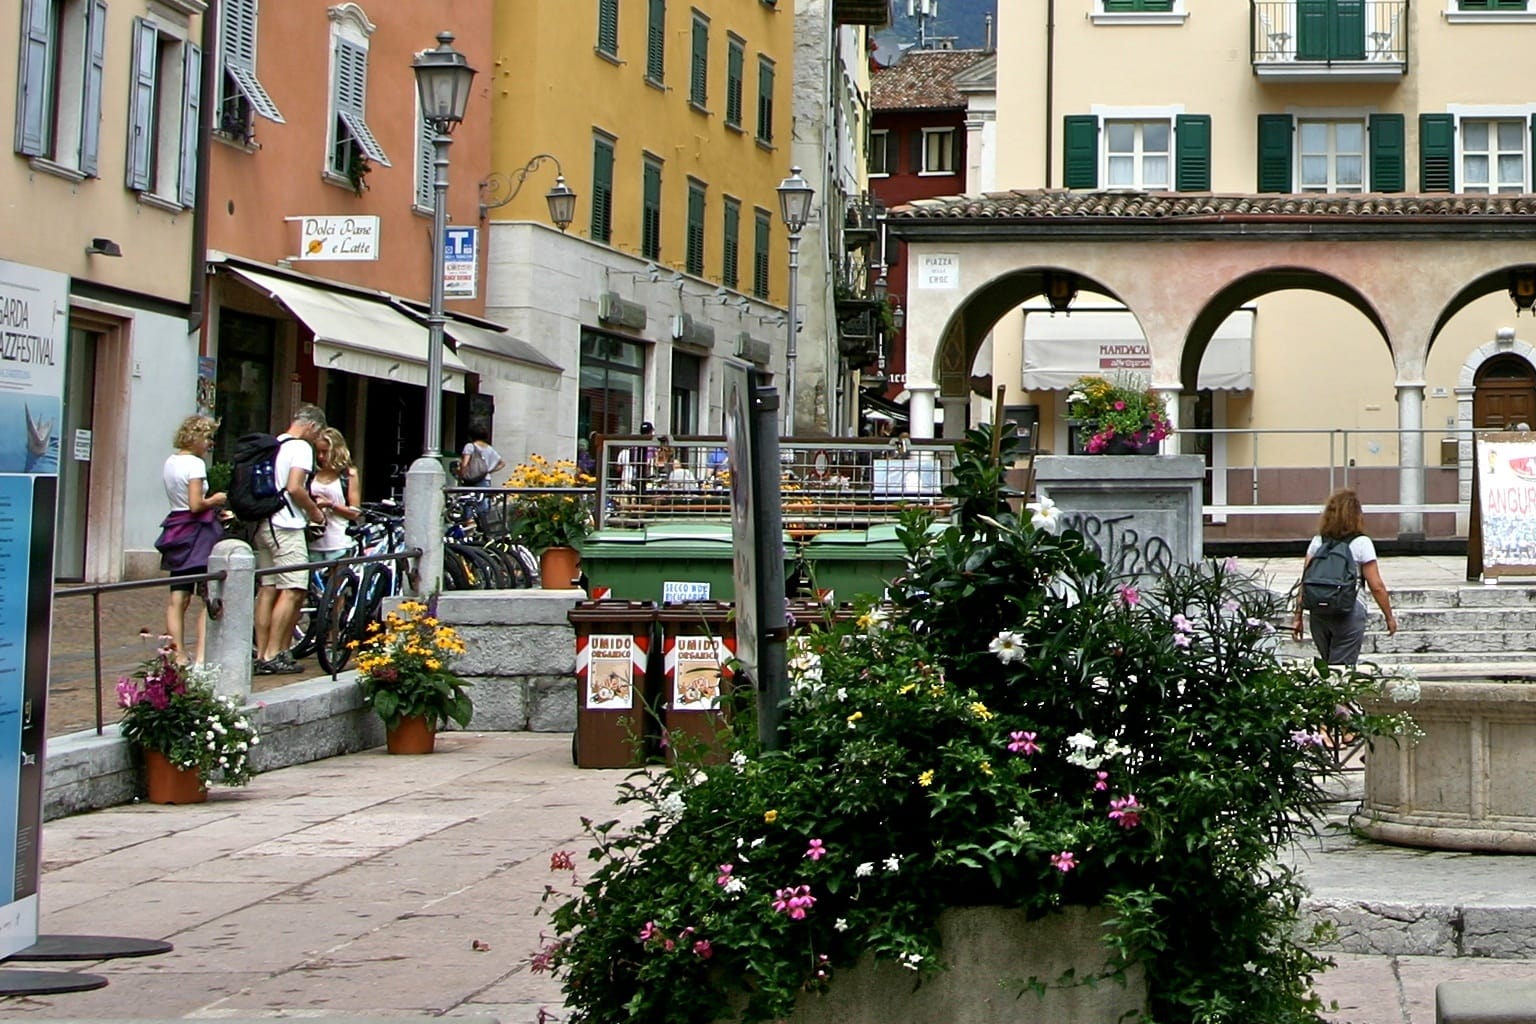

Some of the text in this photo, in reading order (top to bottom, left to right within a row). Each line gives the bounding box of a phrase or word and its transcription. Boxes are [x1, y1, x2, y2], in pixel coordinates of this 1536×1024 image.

[305, 219, 372, 236] Dolci Pane
[332, 237, 371, 254] e Latte
[925, 257, 952, 266] PIAZZA
[665, 583, 689, 593] SECCO
[591, 638, 631, 649] UMIDO
[678, 640, 718, 651] UMIDO
[591, 650, 631, 658] ORGANICO
